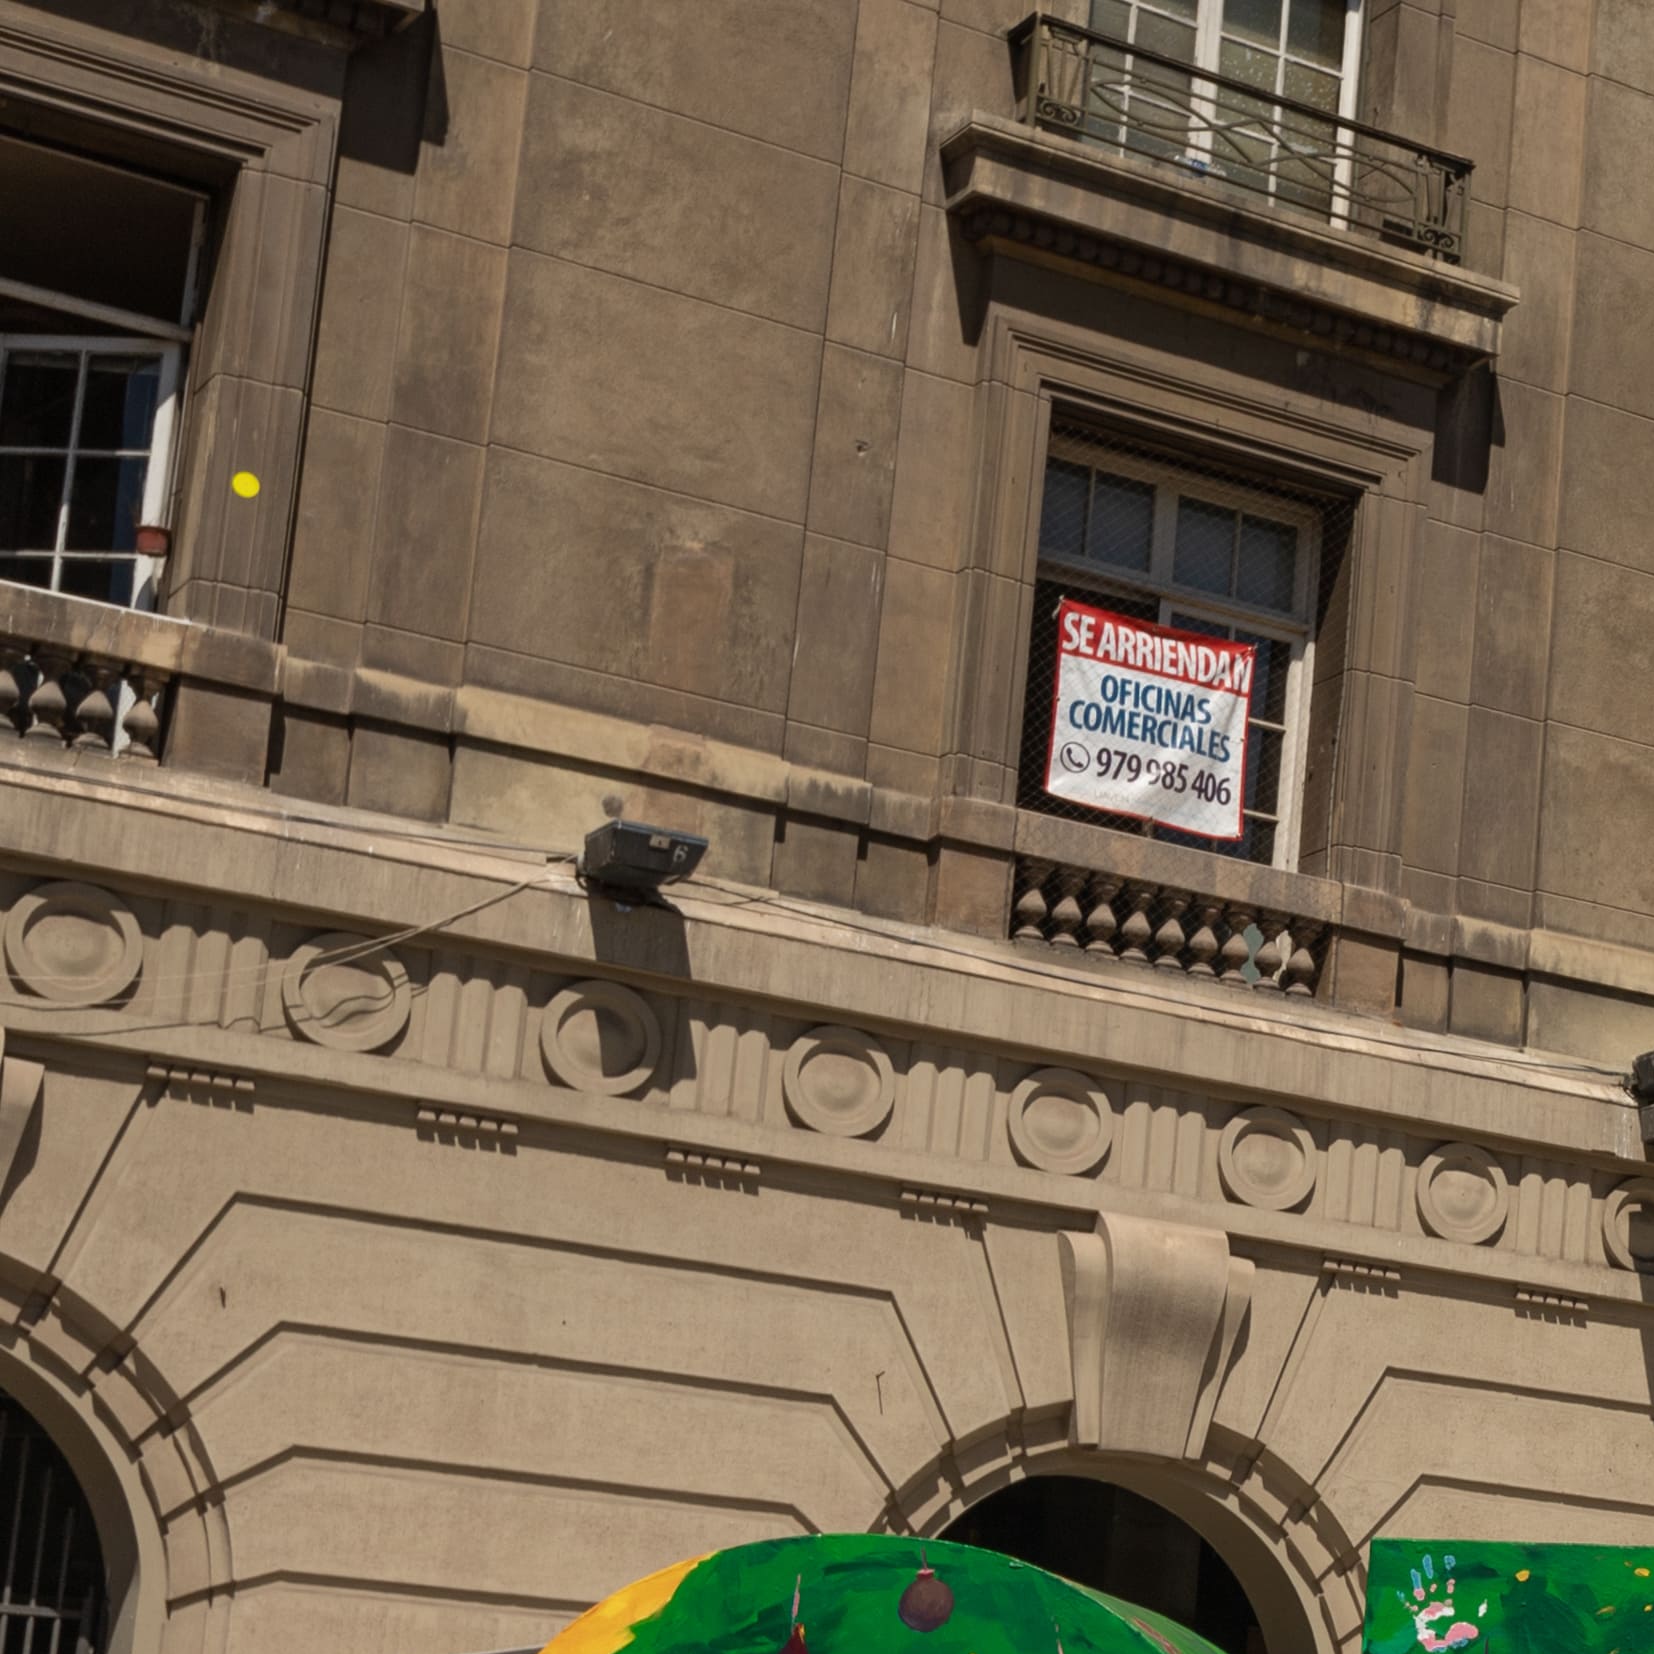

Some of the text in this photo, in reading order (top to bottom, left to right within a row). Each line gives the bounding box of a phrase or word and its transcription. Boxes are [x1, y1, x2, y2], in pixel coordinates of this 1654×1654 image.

[1062, 611, 1252, 694] SE ARRIENDAN
[1100, 674, 1213, 725] OFICINAS
[1069, 699, 1231, 764] COMERCIALES
[1096, 747, 1232, 806] 979 985 406
